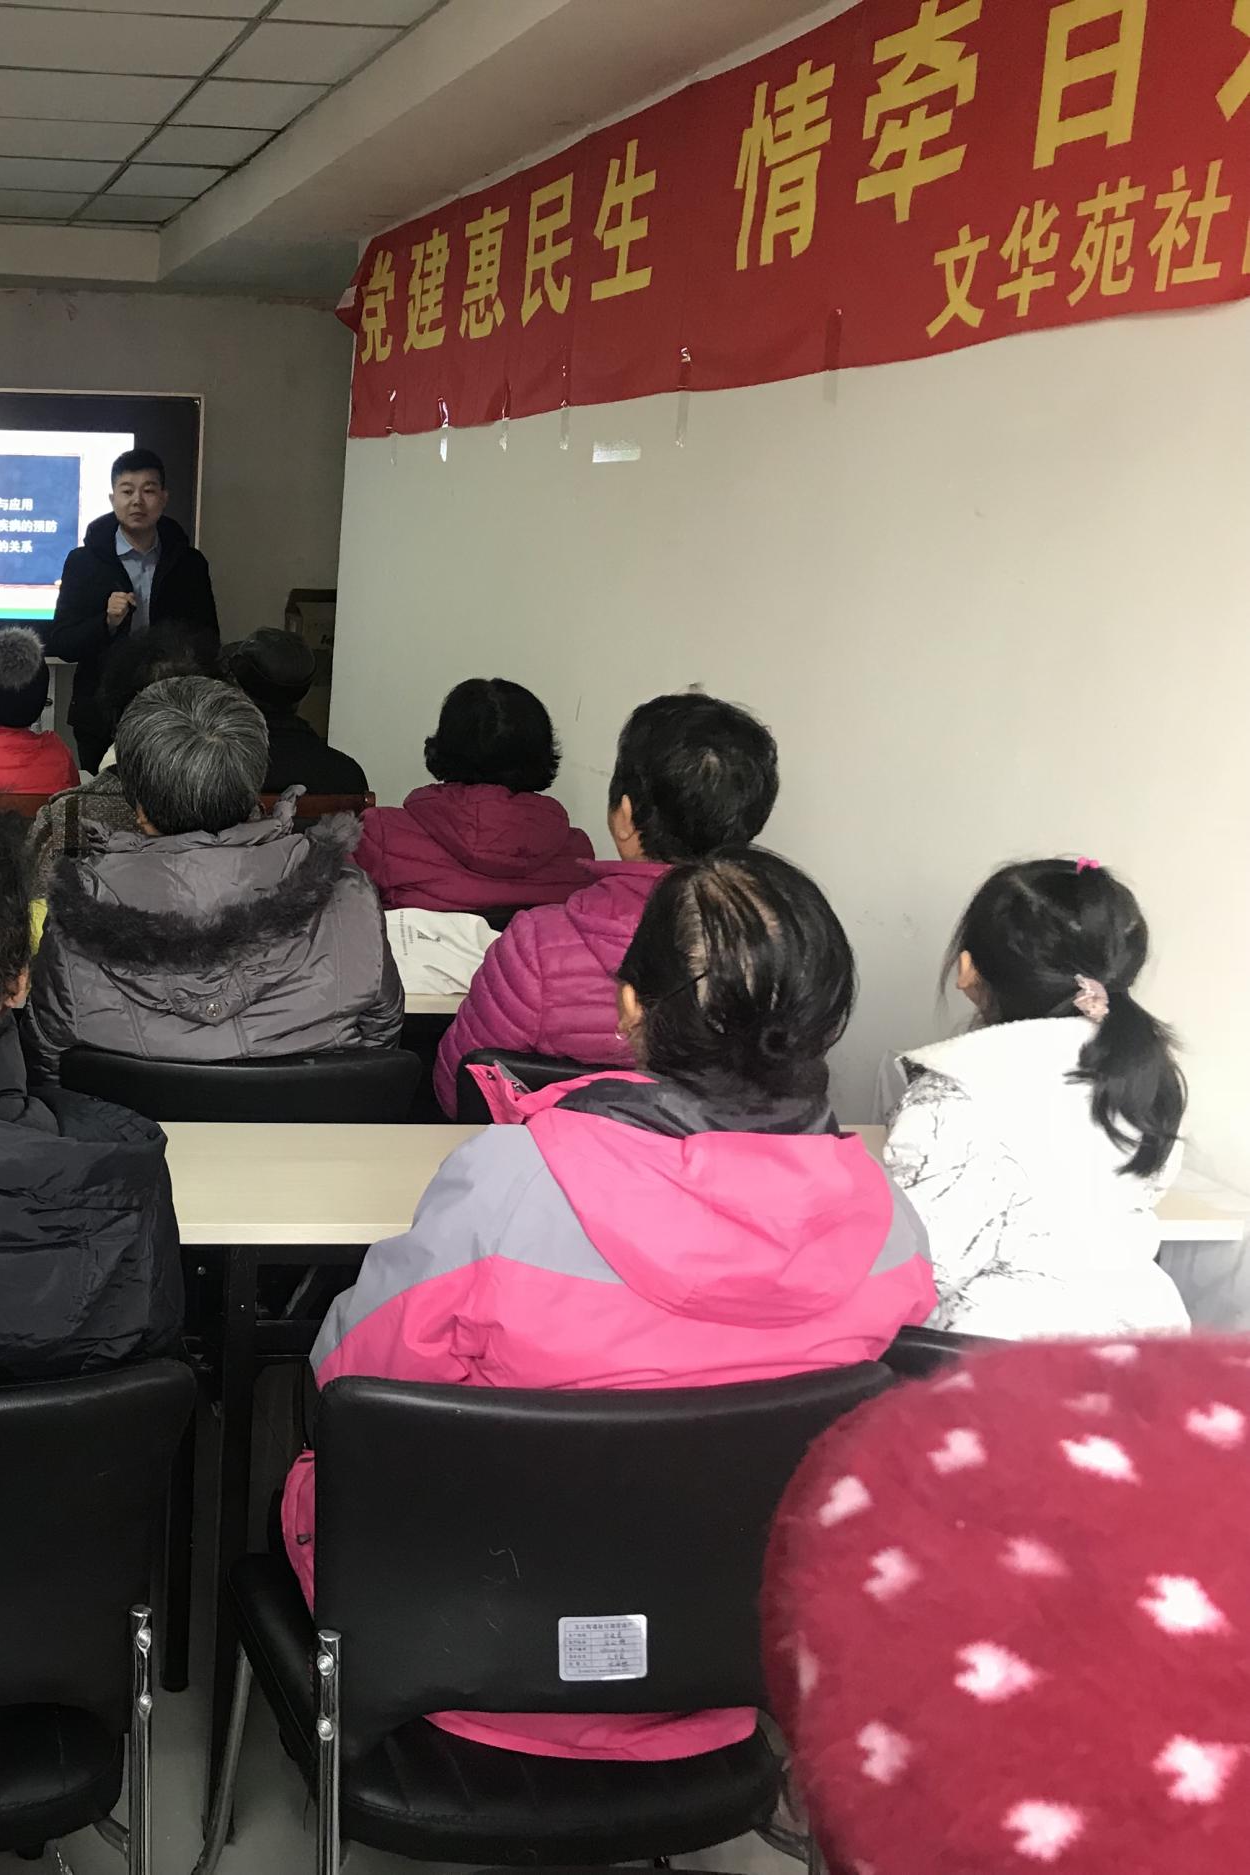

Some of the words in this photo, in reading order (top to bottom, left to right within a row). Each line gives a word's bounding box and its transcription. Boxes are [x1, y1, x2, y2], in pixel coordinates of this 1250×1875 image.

[361, 139, 656, 364] 党建惠民生
[926, 160, 1250, 339] 文华苑社
